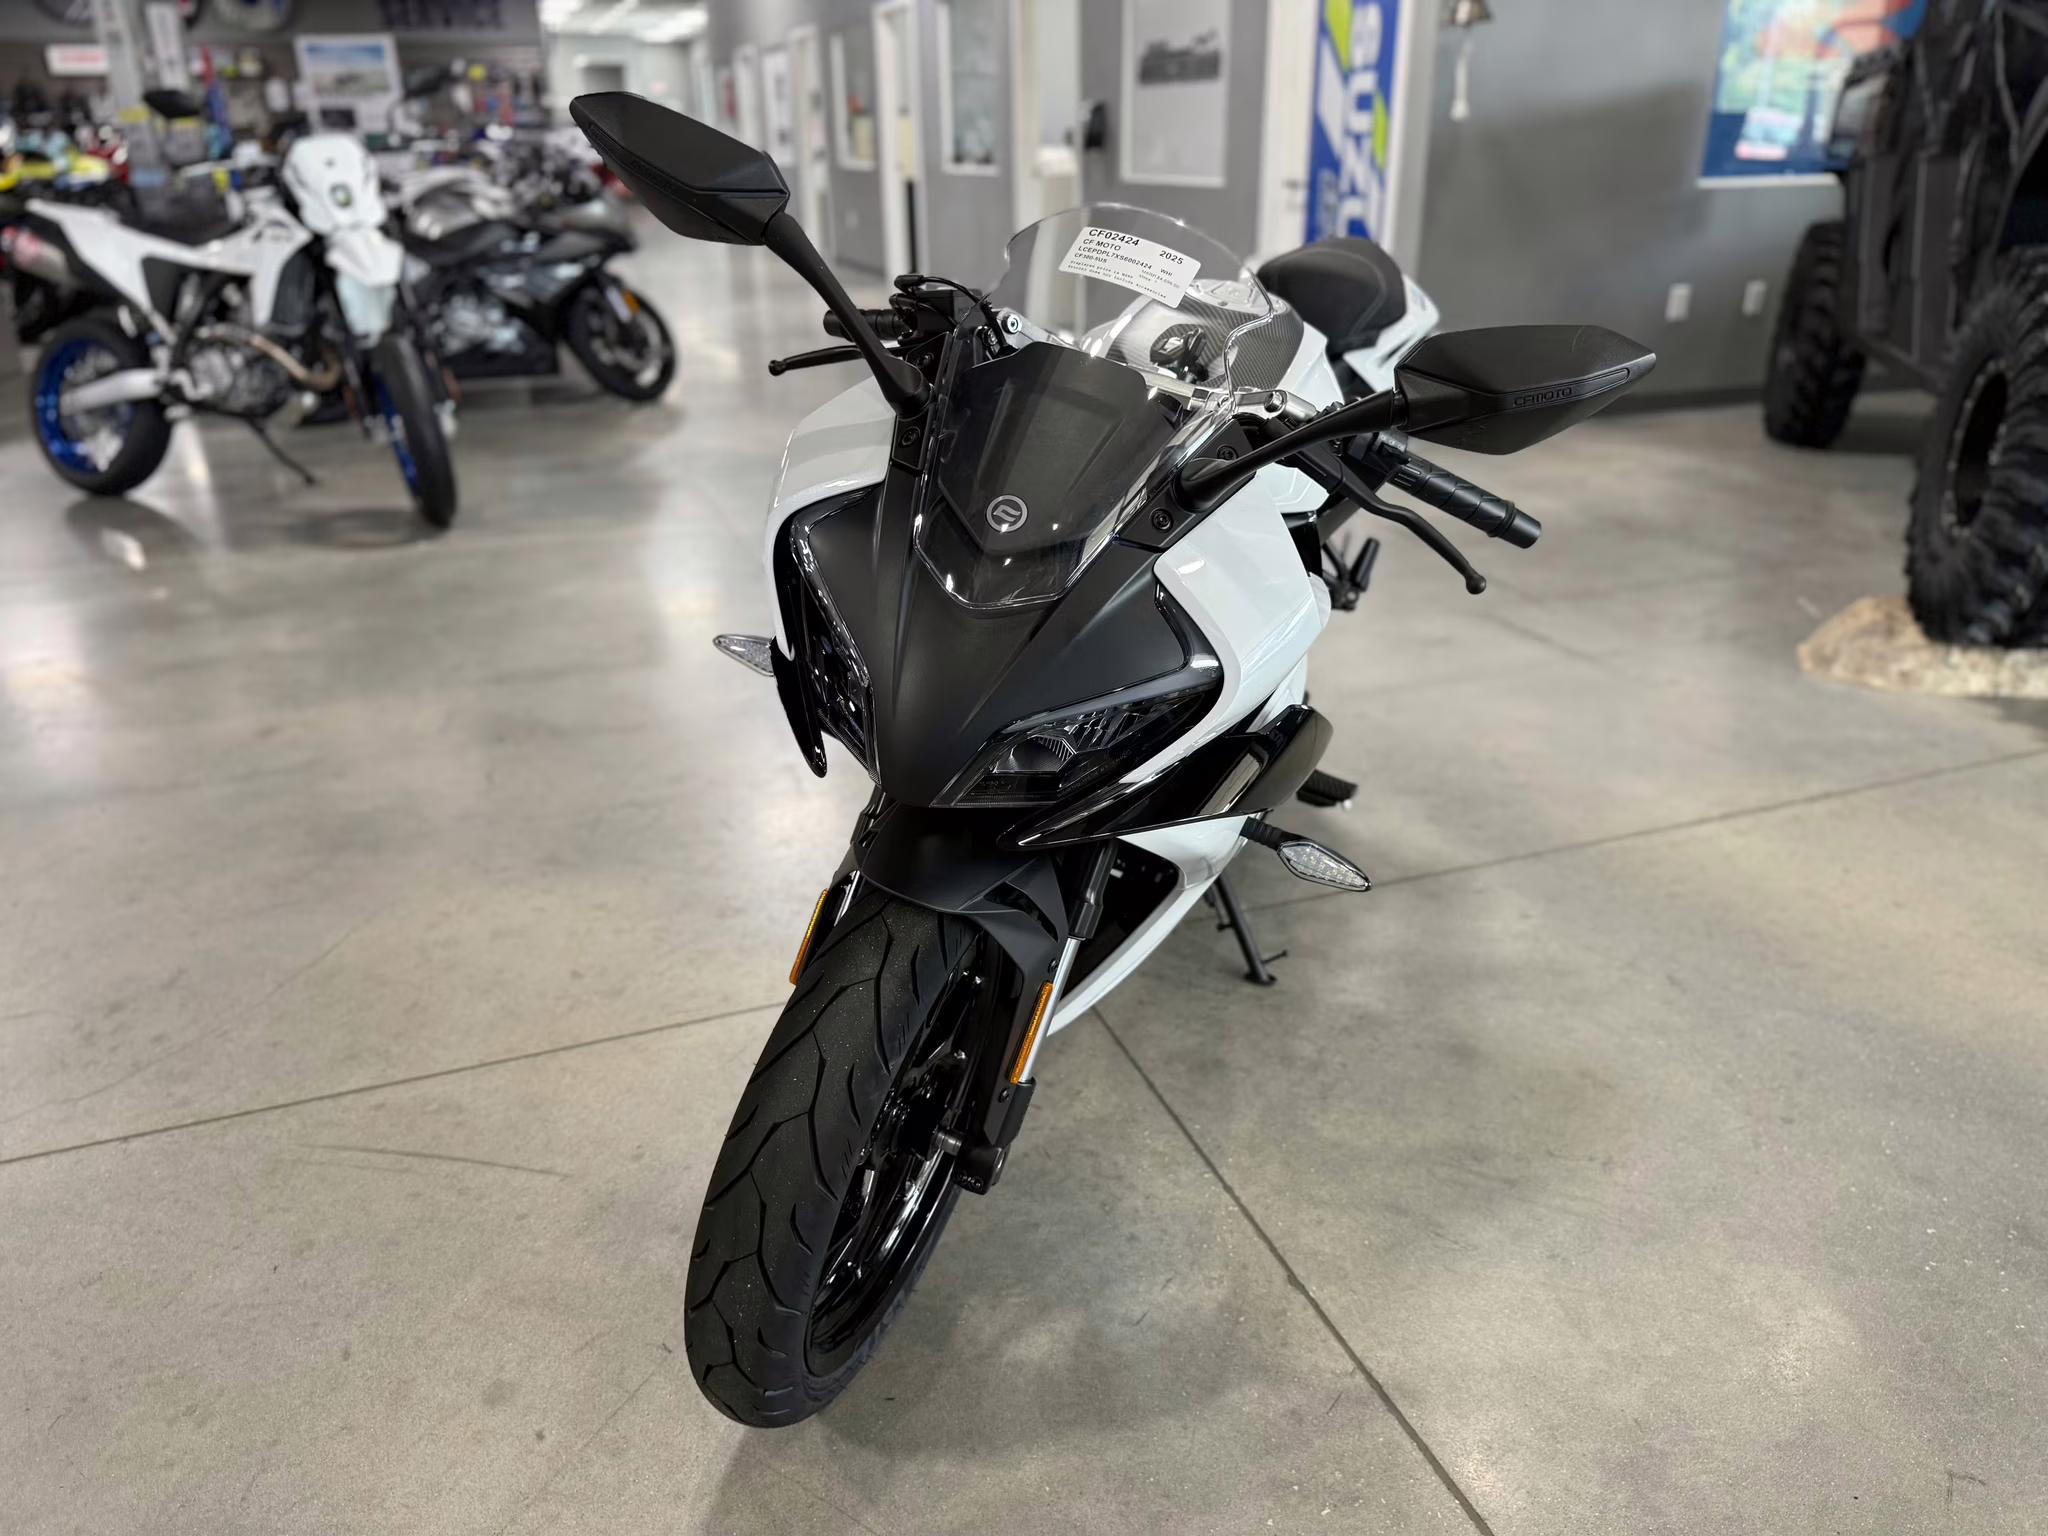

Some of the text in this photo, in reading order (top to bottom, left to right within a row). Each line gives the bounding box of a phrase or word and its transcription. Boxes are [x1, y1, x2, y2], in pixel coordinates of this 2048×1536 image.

[1088, 228, 1140, 246] CF02424
[1096, 241, 1122, 251] MOTO
[1159, 250, 1184, 265] 2025
[1513, 387, 1572, 407] CFMOTO
